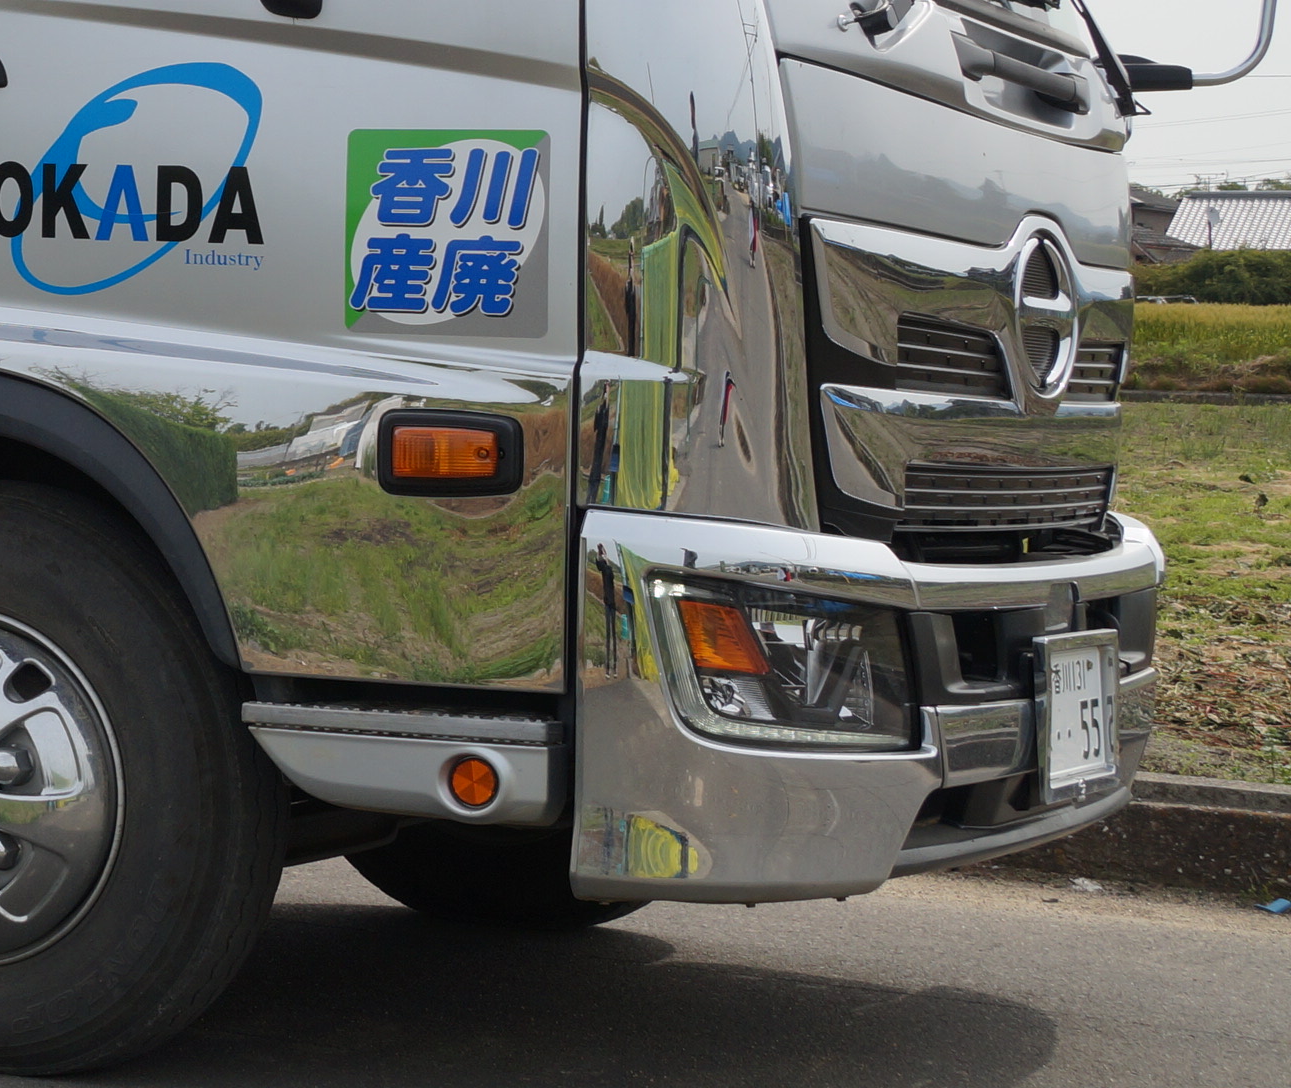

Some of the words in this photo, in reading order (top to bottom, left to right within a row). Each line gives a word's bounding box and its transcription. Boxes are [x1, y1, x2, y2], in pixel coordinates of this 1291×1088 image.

[370, 146, 541, 230] 香川
[183, 247, 265, 271] Industry
[348, 232, 524, 318] 産廃
